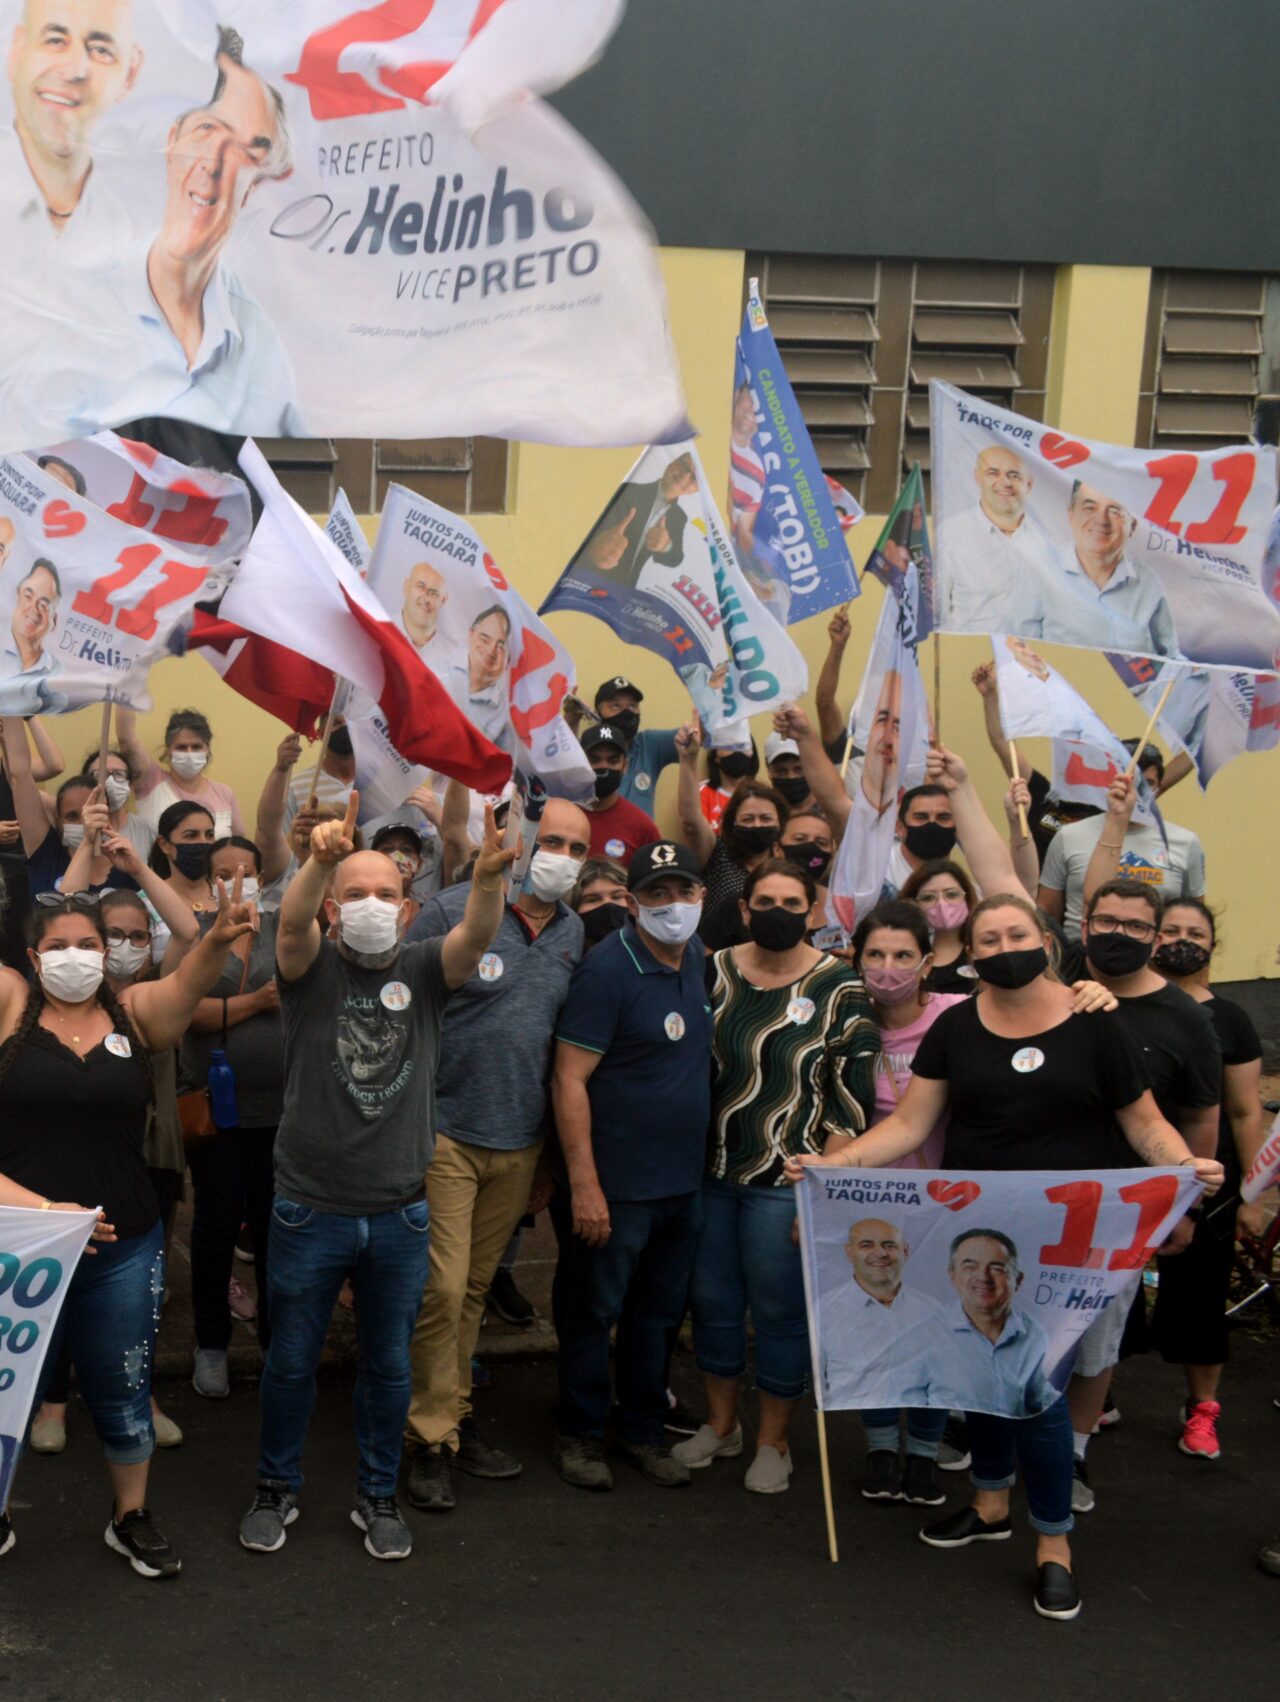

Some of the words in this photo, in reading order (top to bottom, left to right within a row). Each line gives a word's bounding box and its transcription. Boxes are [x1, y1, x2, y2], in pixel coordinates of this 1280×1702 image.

[317, 132, 434, 177] PREFEITO
[344, 166, 594, 256] Helinho
[757, 368, 796, 459] CANDIDATO
[1003, 423, 1034, 442] POR
[0, 458, 28, 491] JUNTOS
[787, 456, 799, 470] A
[792, 471, 830, 550] VEREADOR
[1143, 452, 1256, 545] 11
[403, 521, 477, 567] TAQUARA
[406, 509, 455, 537] JUNTOS
[453, 532, 480, 553] POR
[769, 483, 821, 596] (TOBI)
[71, 543, 212, 641] 11
[66, 617, 113, 644] PREFEITO
[825, 1178, 882, 1190] JUNTOS
[885, 1181, 917, 1192] POR
[826, 1187, 920, 1206] TAQUARA
[1039, 1174, 1179, 1271] 11
[1040, 1271, 1105, 1286] PREFEITO
